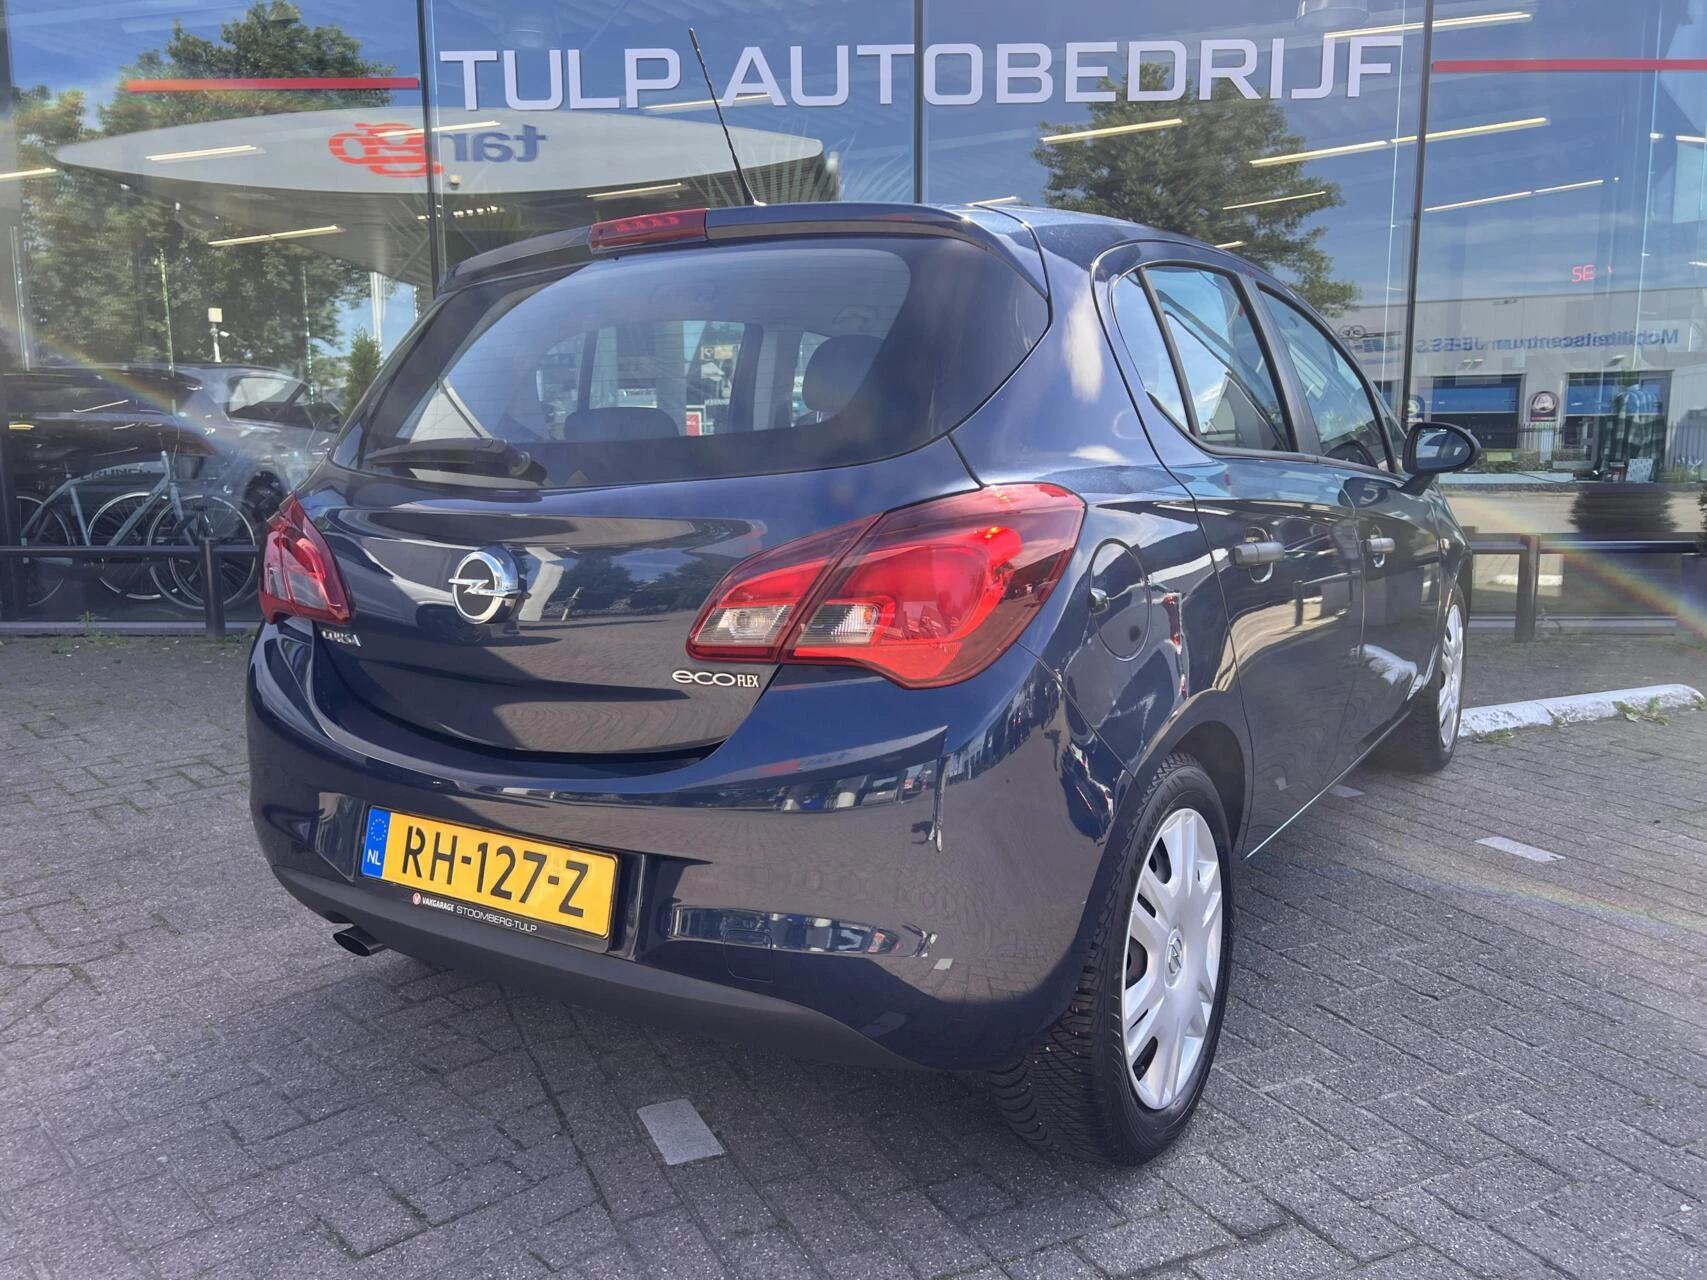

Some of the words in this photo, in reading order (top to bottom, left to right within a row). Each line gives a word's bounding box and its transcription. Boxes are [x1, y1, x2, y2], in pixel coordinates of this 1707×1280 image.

[439, 48, 681, 111] TULP
[721, 36, 1404, 108] AUTOBEDRIJF
[366, 848, 381, 867] NL
[402, 825, 589, 918] RH-127-Z
[422, 896, 455, 912] VAKGARAGE
[456, 905, 537, 933] STOOMBERG-TULP
